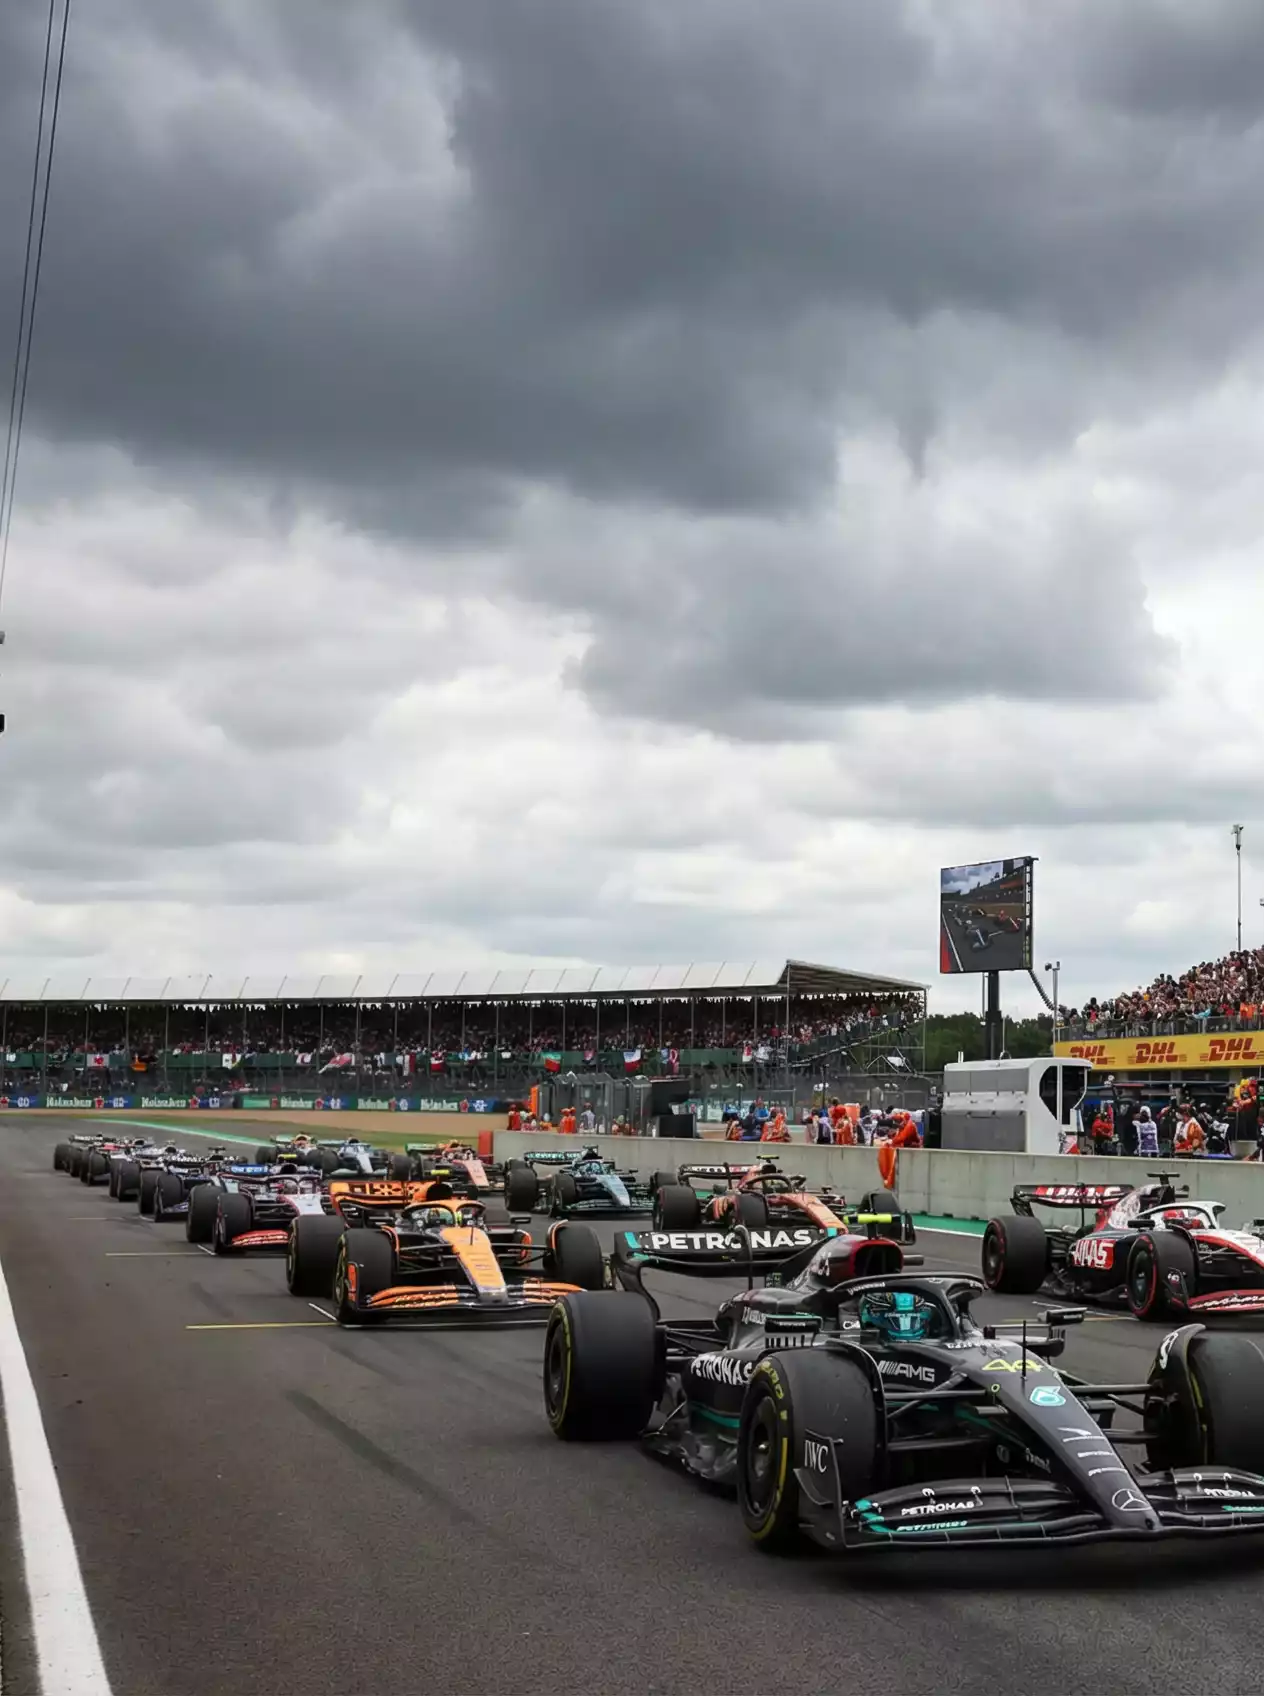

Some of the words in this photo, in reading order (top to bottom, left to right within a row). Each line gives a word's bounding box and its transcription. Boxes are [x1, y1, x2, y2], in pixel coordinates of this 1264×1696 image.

[1069, 1044, 1109, 1065] DHL
[1135, 1041, 1179, 1064] DHL
[1208, 1037, 1257, 1061] DHL
[651, 1229, 812, 1250] PETRONAS
[896, 1363, 936, 1383] AMG
[804, 1439, 829, 1473] IWC
[901, 1501, 975, 1516] PETRONAS
